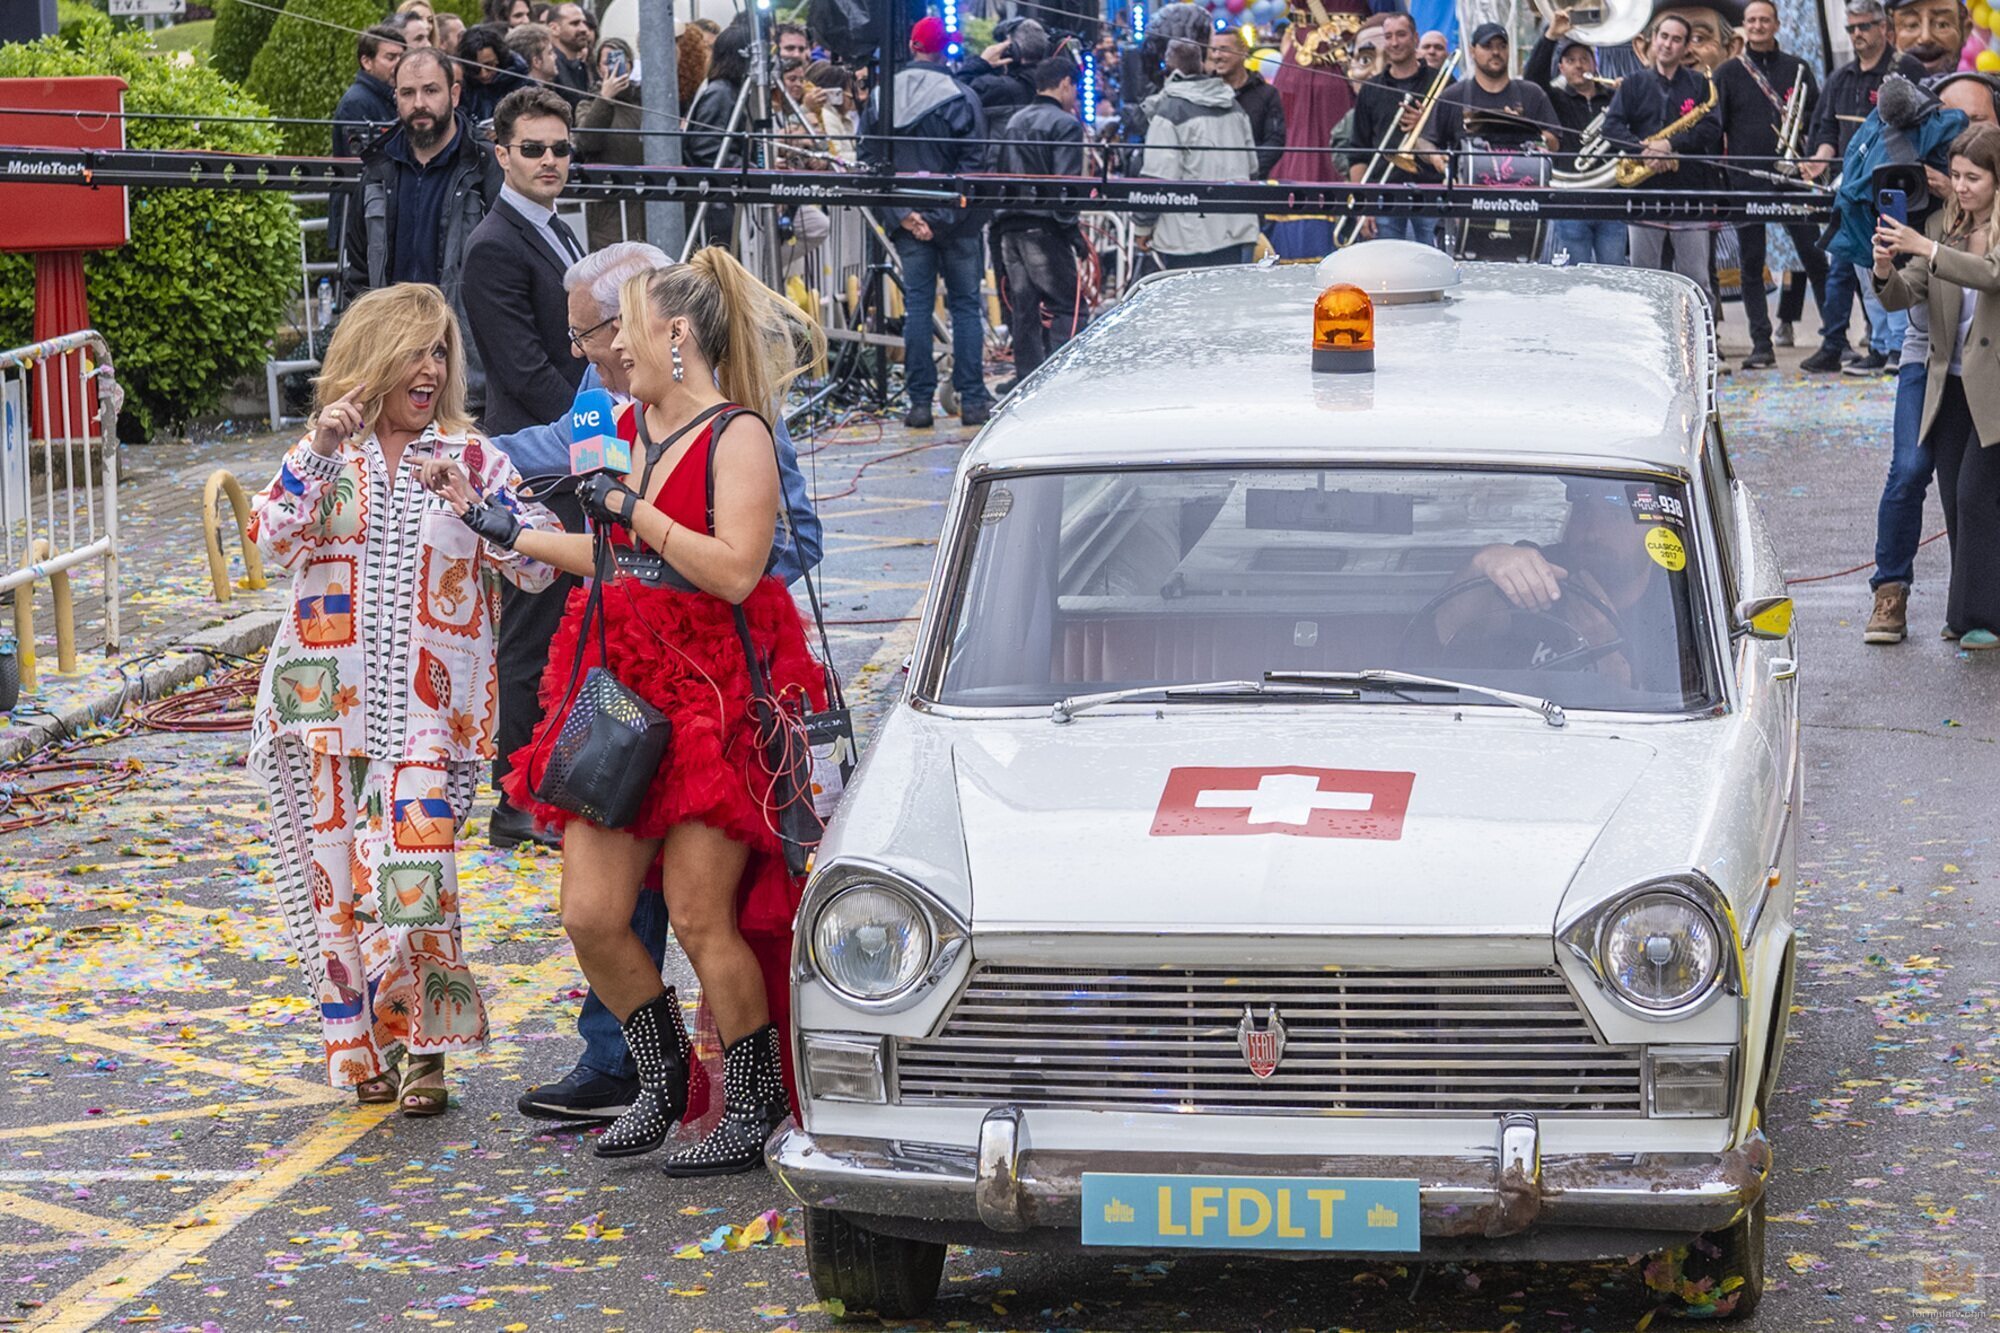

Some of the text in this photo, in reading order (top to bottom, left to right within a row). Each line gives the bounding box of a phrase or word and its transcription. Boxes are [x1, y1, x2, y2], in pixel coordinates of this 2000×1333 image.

[1128, 191, 1198, 205] MovieTech
[1472, 198, 1539, 211] MovieTech
[573, 410, 600, 428] tve
[1658, 495, 1684, 518] 938
[1250, 1033, 1275, 1060] SEAT
[1158, 1186, 1346, 1238] LFDLT
